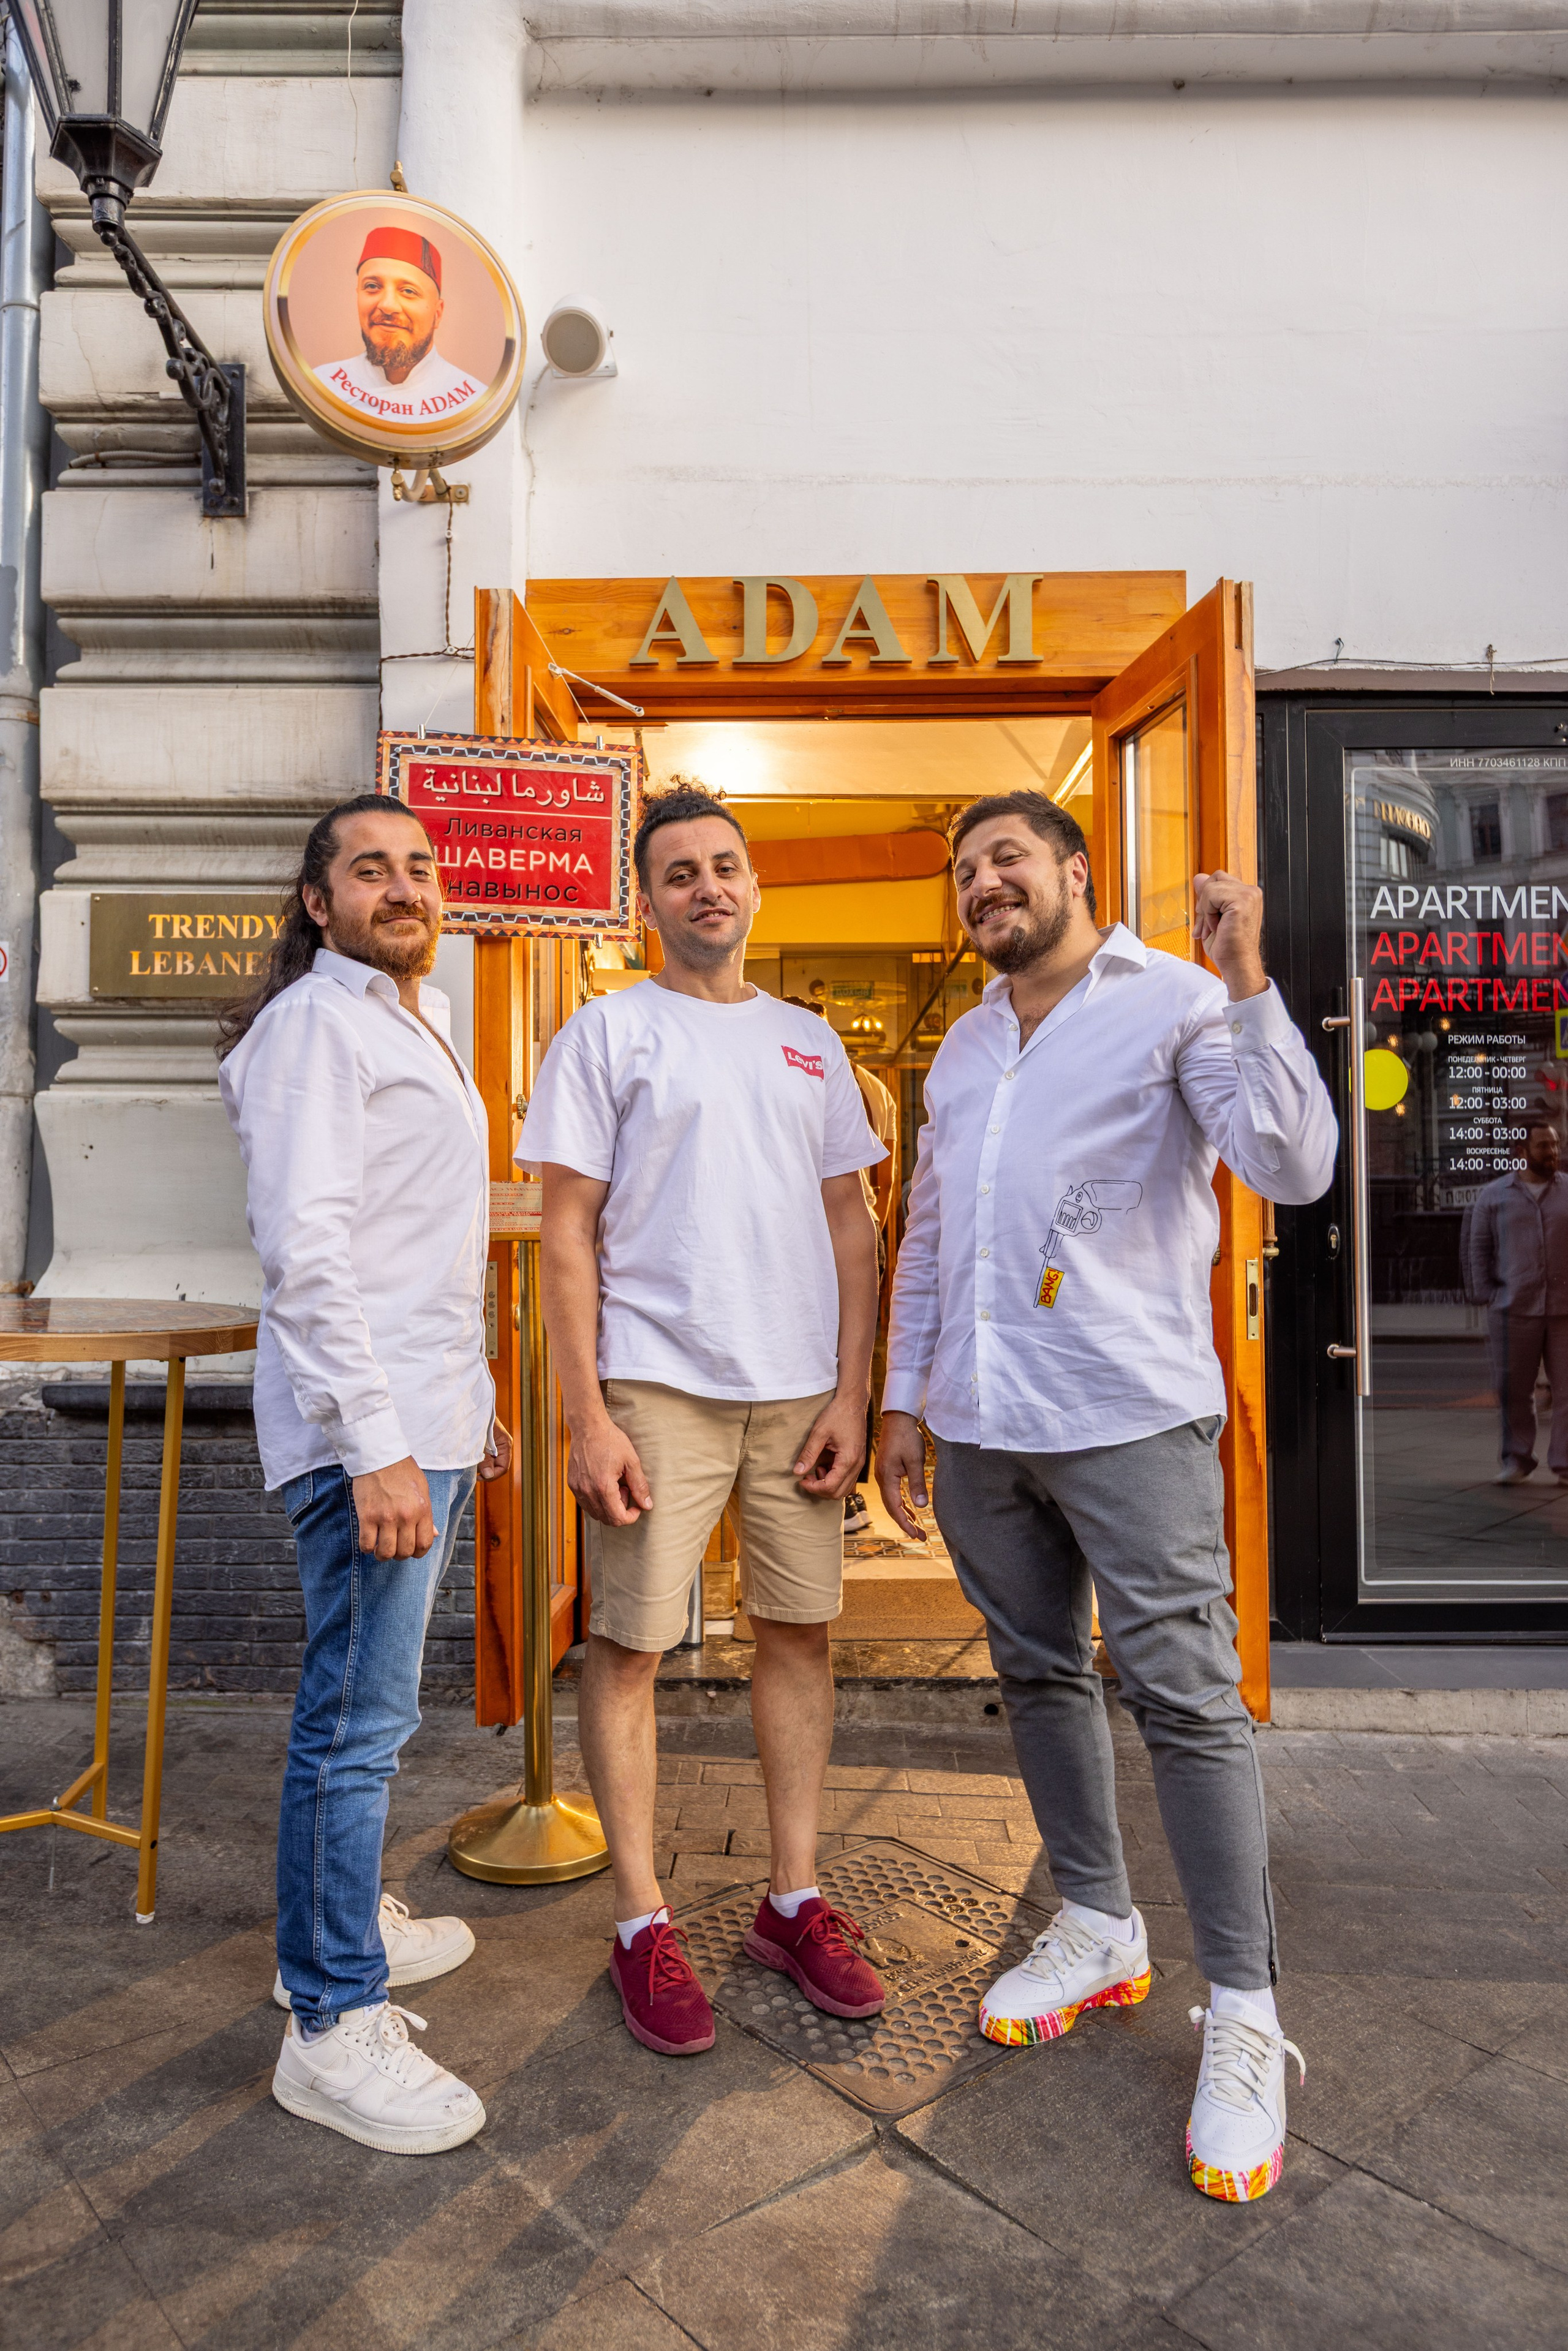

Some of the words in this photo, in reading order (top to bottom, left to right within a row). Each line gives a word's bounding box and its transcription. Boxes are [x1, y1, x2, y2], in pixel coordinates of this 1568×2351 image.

[330, 367, 414, 416] Ресторан
[419, 379, 477, 416] ADAM
[628, 574, 1044, 666] ADAM
[1450, 758, 1474, 768] ИНН
[1478, 758, 1540, 768] 7703461128
[1543, 758, 1566, 768] КПП
[423, 768, 502, 805] لبنانية
[512, 773, 605, 809] شاورما
[444, 818, 582, 843] Ливанская
[434, 845, 594, 875] ШАВЕРМА
[448, 880, 579, 902] навынос
[148, 914, 286, 939] TRENDY
[129, 951, 273, 976] LEBANE
[1448, 1035, 1485, 1044] РЕЖИМ
[1487, 1035, 1526, 1044] РАБОТЫ
[1449, 1066, 1482, 1078] 12:00
[1492, 1066, 1526, 1078] 00:00
[1450, 1097, 1482, 1109] 12:00
[1493, 1097, 1526, 1109] 03:00
[1450, 1128, 1483, 1140] 14:00
[1493, 1128, 1527, 1140] 03:00
[1450, 1158, 1483, 1171] 14:00
[1493, 1158, 1527, 1171] 00:00
[1041, 1269, 1060, 1304] BANG!
